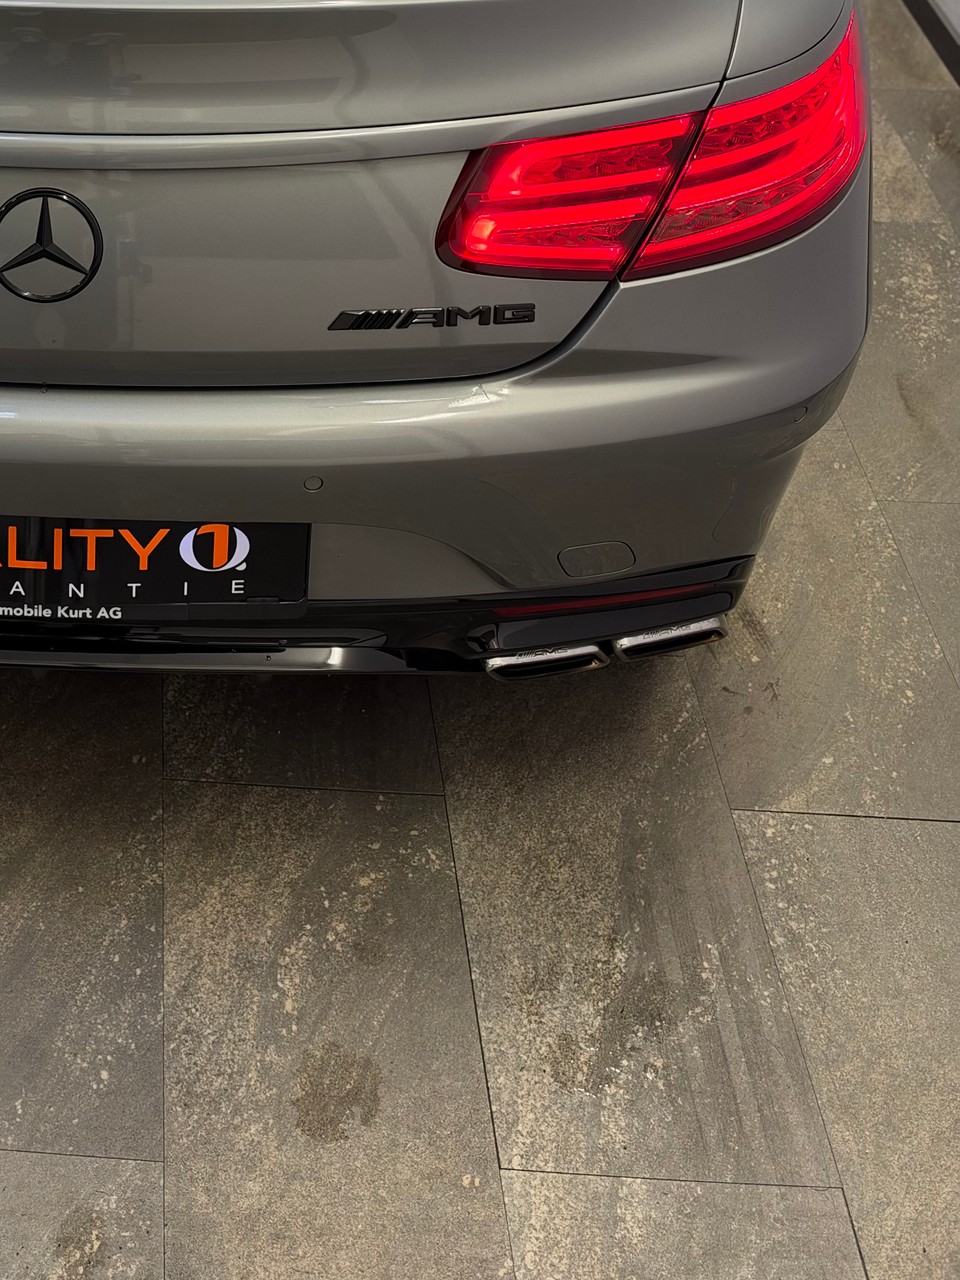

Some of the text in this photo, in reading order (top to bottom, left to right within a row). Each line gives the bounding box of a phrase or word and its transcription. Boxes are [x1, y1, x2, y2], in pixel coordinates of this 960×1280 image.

[395, 302, 536, 329] AMG
[57, 605, 93, 619] Kurt
[96, 606, 123, 620] AG
